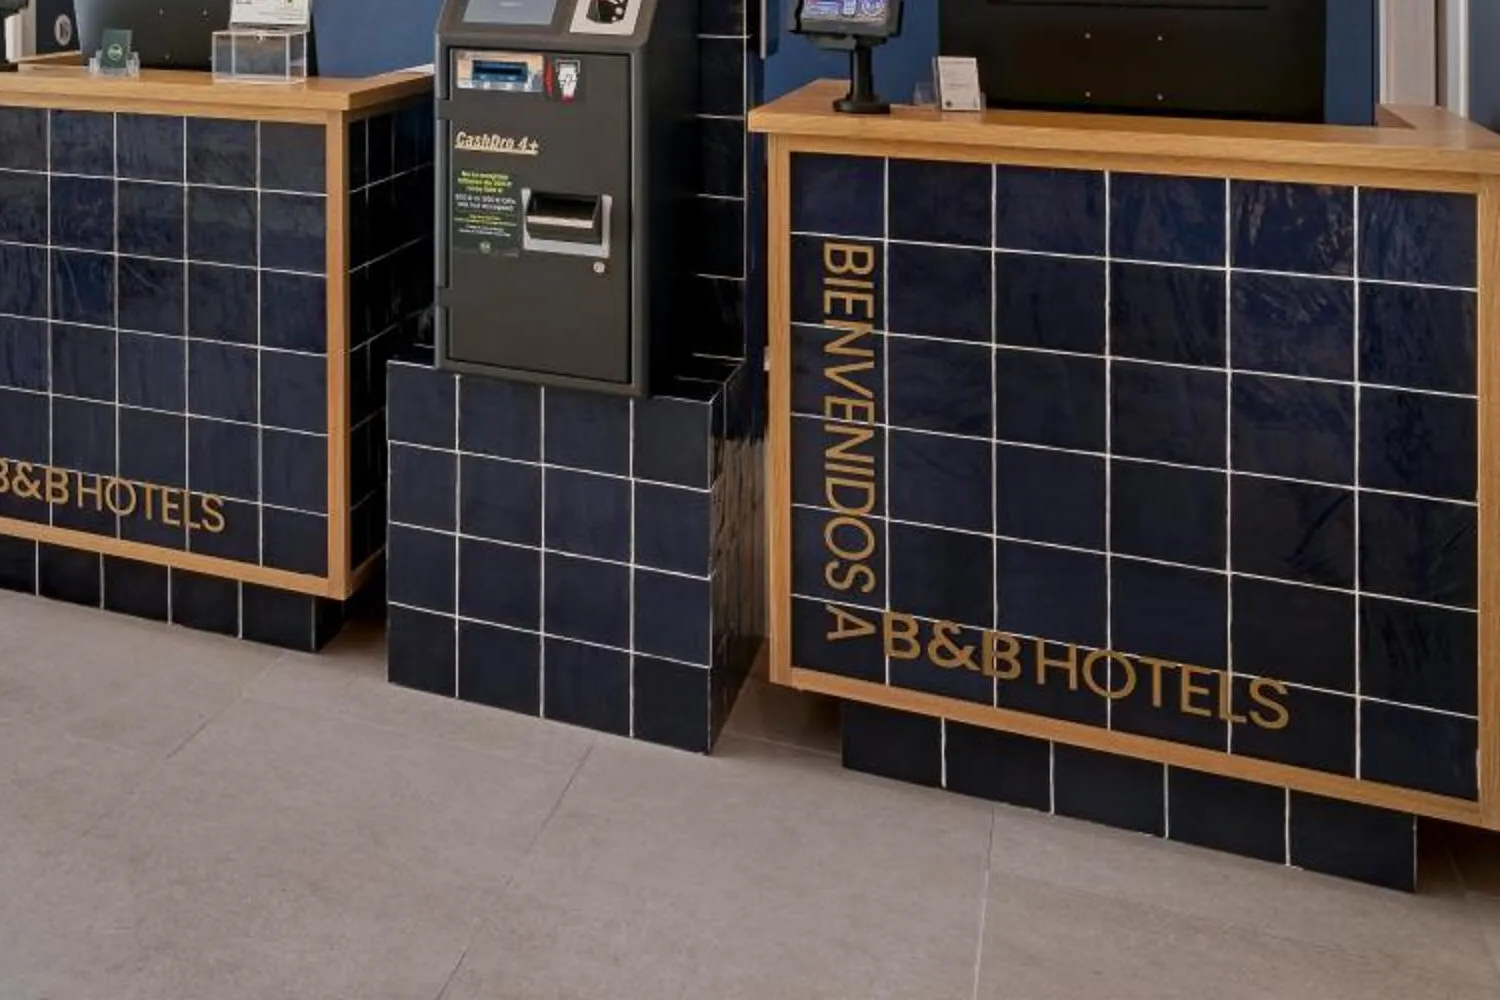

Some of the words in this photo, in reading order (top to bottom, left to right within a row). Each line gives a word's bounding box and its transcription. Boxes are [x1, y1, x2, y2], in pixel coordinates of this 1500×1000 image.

[823, 241, 876, 594] BIENVENIDOS
[77, 471, 226, 533] HOTELS
[826, 604, 876, 641] A
[882, 611, 1021, 679] B&B
[1036, 638, 1290, 730] HOTELS
